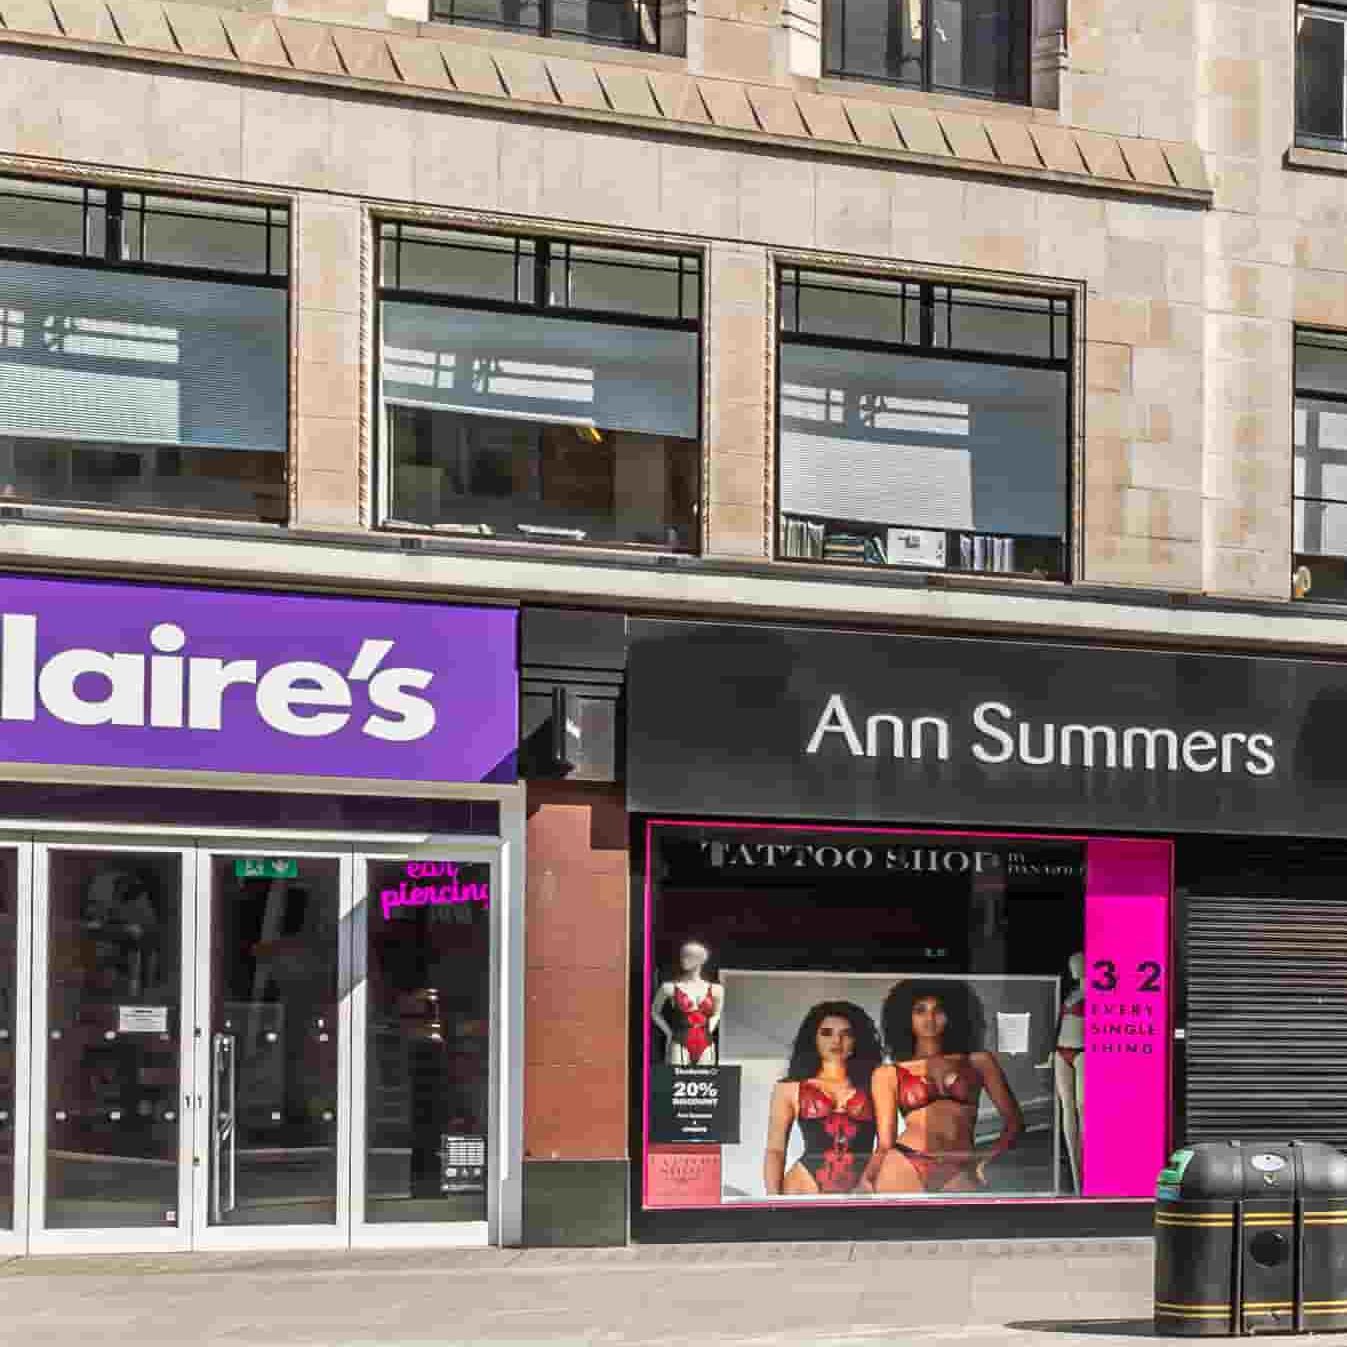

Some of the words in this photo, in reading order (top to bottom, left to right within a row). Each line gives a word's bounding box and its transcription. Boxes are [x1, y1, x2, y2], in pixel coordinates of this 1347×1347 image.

[806, 693, 949, 760] Ann
[971, 700, 1275, 775] Summers
[1092, 960, 1117, 991] 3
[1136, 960, 1162, 992] 2
[673, 1081, 719, 1098] 20%
